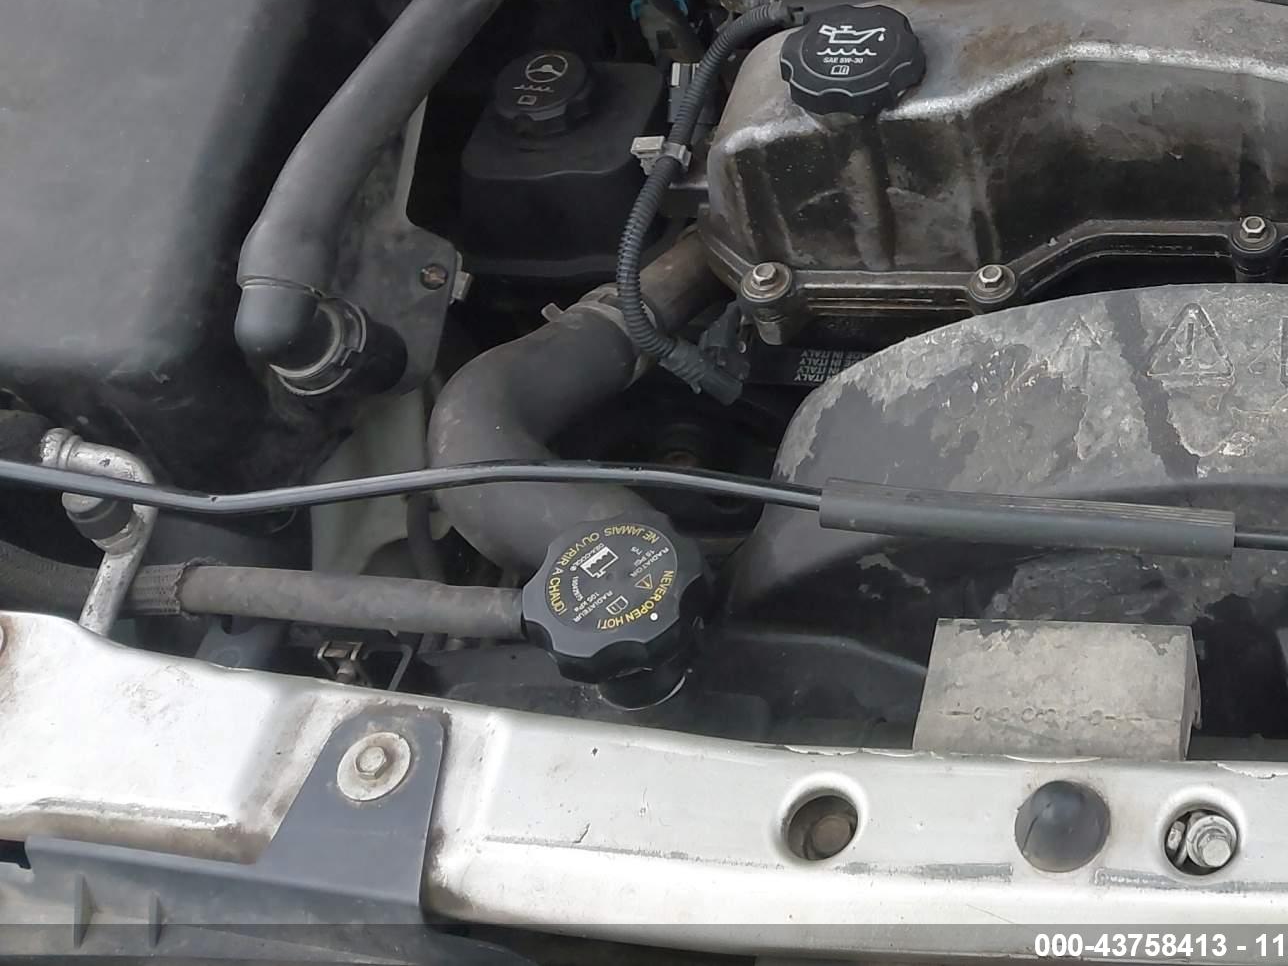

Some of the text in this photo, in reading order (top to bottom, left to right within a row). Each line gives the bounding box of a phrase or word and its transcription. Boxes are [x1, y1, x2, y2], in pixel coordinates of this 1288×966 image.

[603, 525, 645, 538] JAMAIS
[642, 531, 660, 544] NE
[555, 532, 600, 566] OUVRIR
[629, 546, 670, 578] RADIATOR
[571, 589, 614, 624] RADIATEUR
[596, 570, 675, 631] NEVER OPEN HOT!
